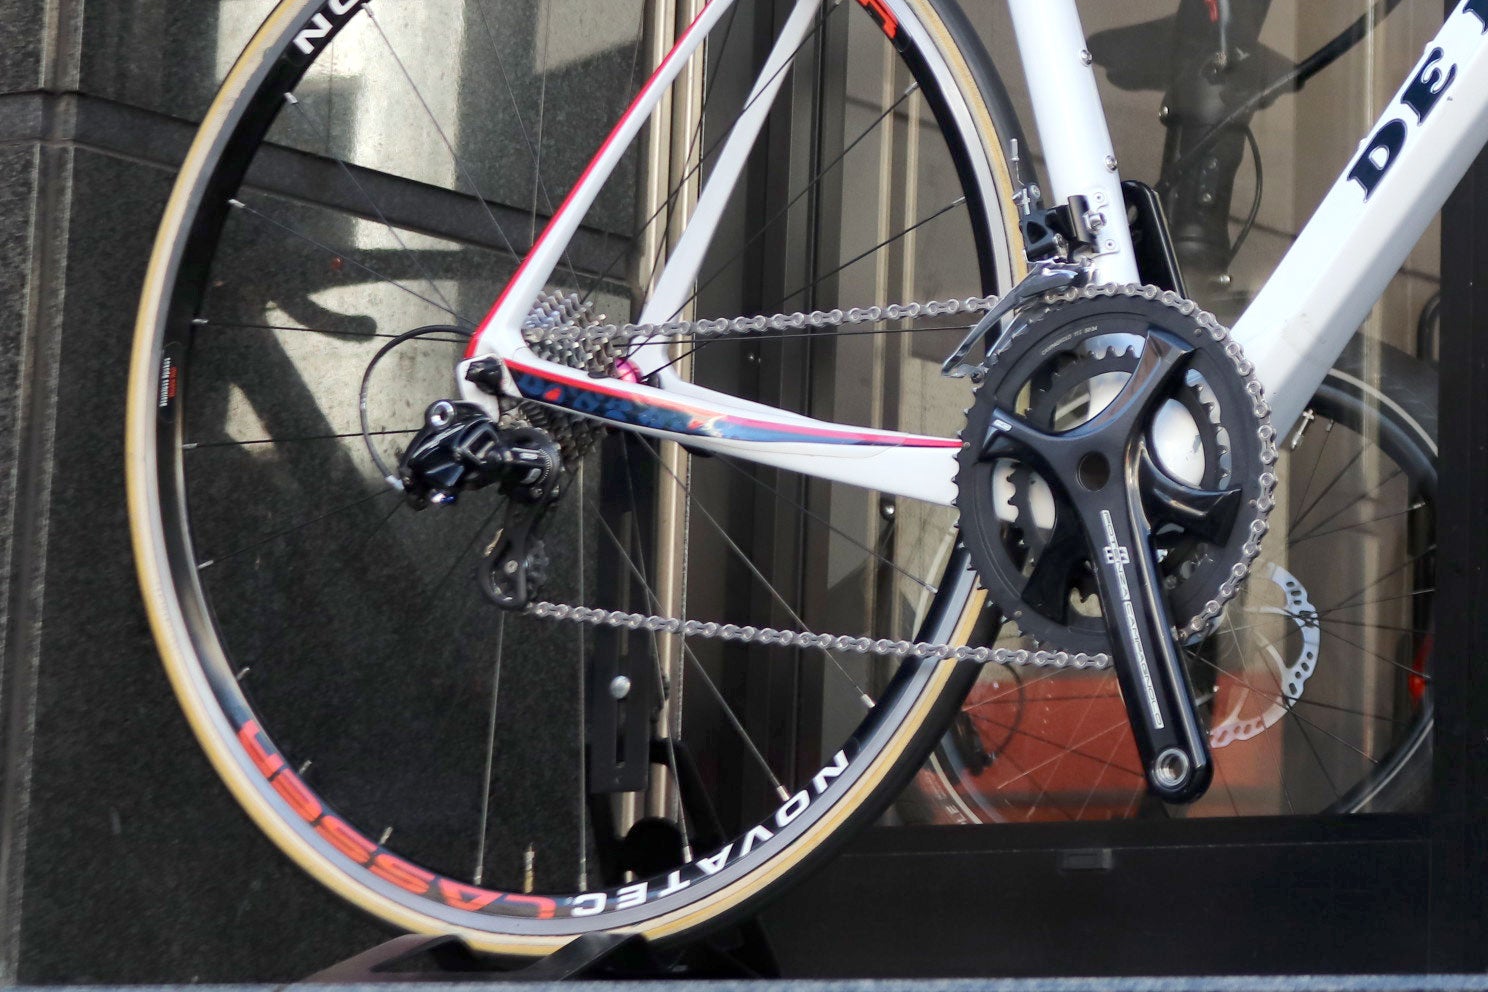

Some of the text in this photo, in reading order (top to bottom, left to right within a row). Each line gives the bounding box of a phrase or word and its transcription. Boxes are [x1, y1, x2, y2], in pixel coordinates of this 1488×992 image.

[1123, 601, 1164, 727] CAMPAGNOLO
[237, 720, 851, 921] NOVATEC LASSER
